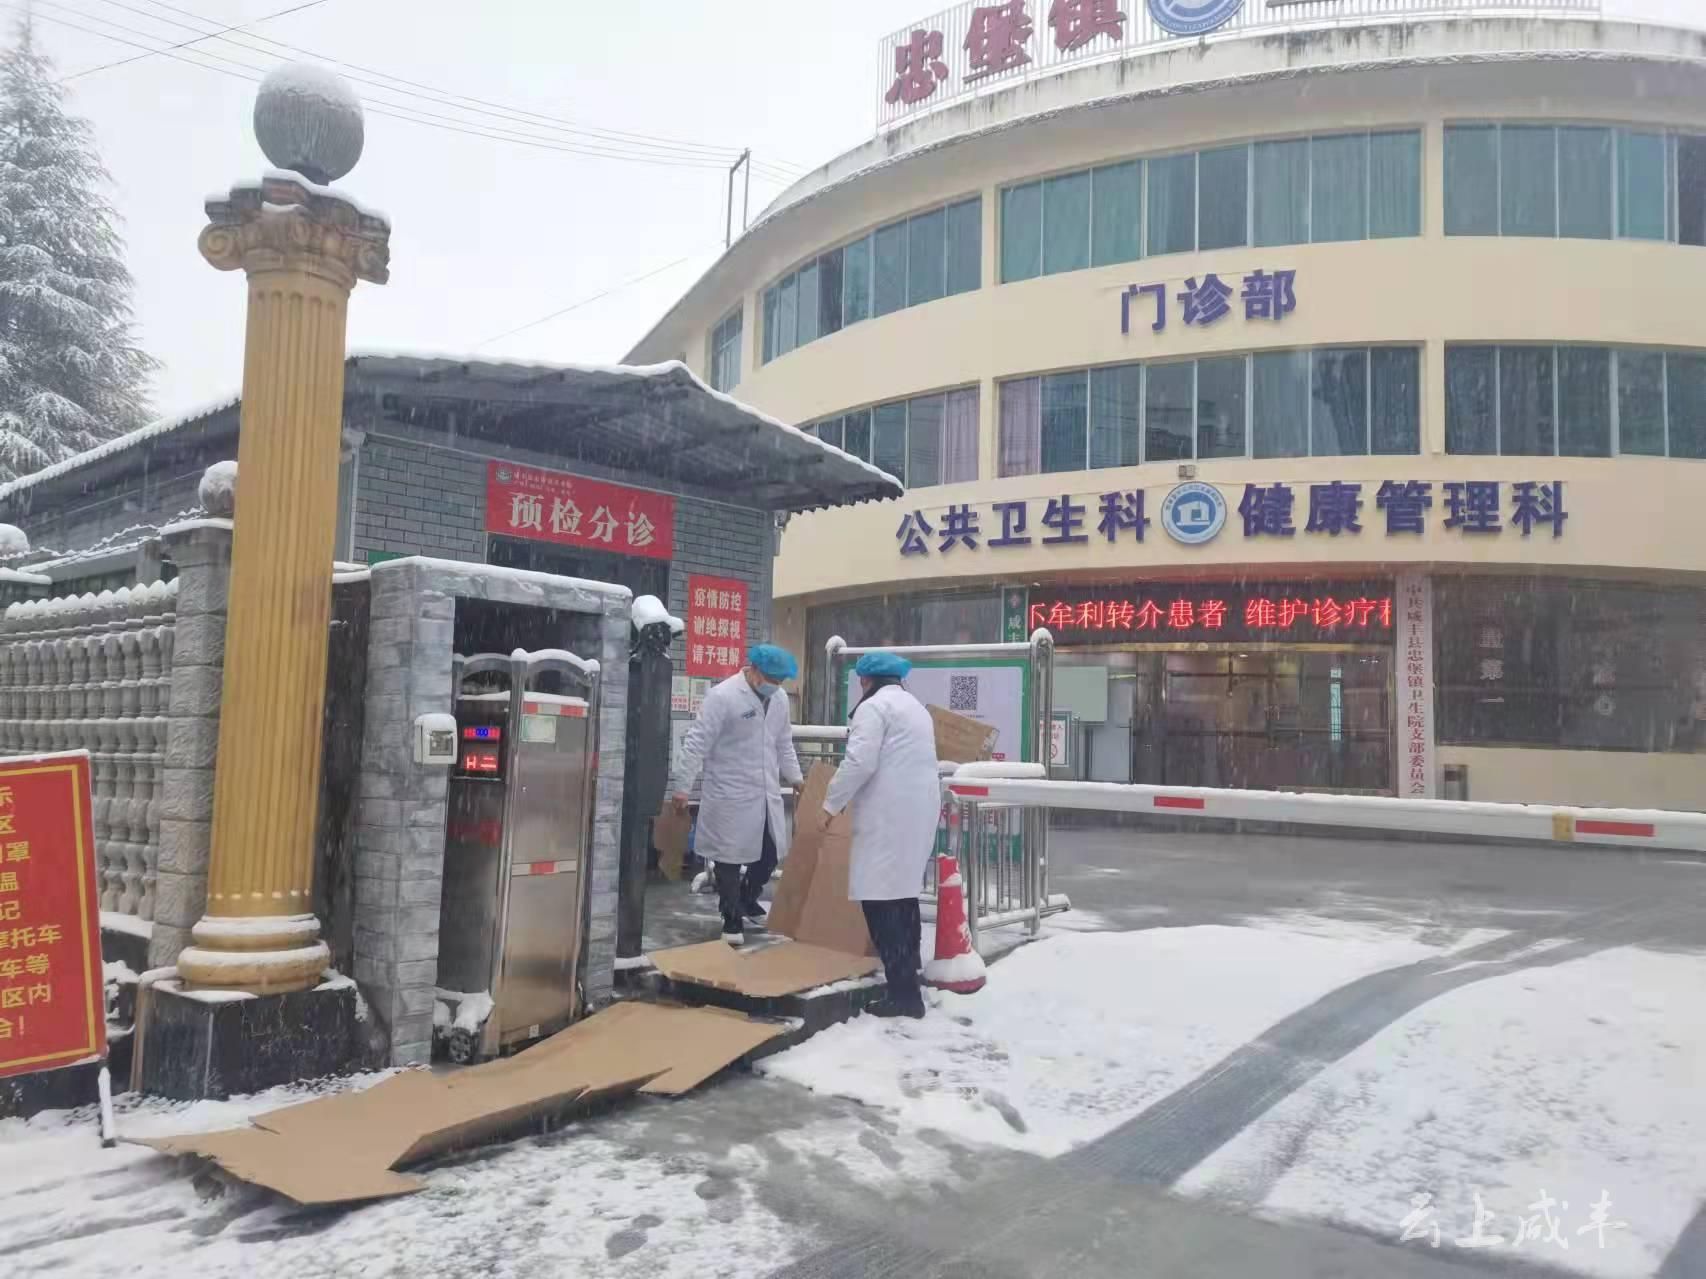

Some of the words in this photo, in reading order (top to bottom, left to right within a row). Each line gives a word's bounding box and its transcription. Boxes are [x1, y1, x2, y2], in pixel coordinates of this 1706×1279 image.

[1121, 267, 1298, 335] 门诊部
[508, 492, 656, 547] 预检分诊
[895, 487, 1152, 557] 公共卫生科
[1238, 481, 1569, 537] 健康管理科
[693, 587, 743, 613] 疫情防控
[692, 614, 742, 640] 谢绝探视
[691, 646, 741, 668] 请予理解
[2, 982, 51, 1009] 区内
